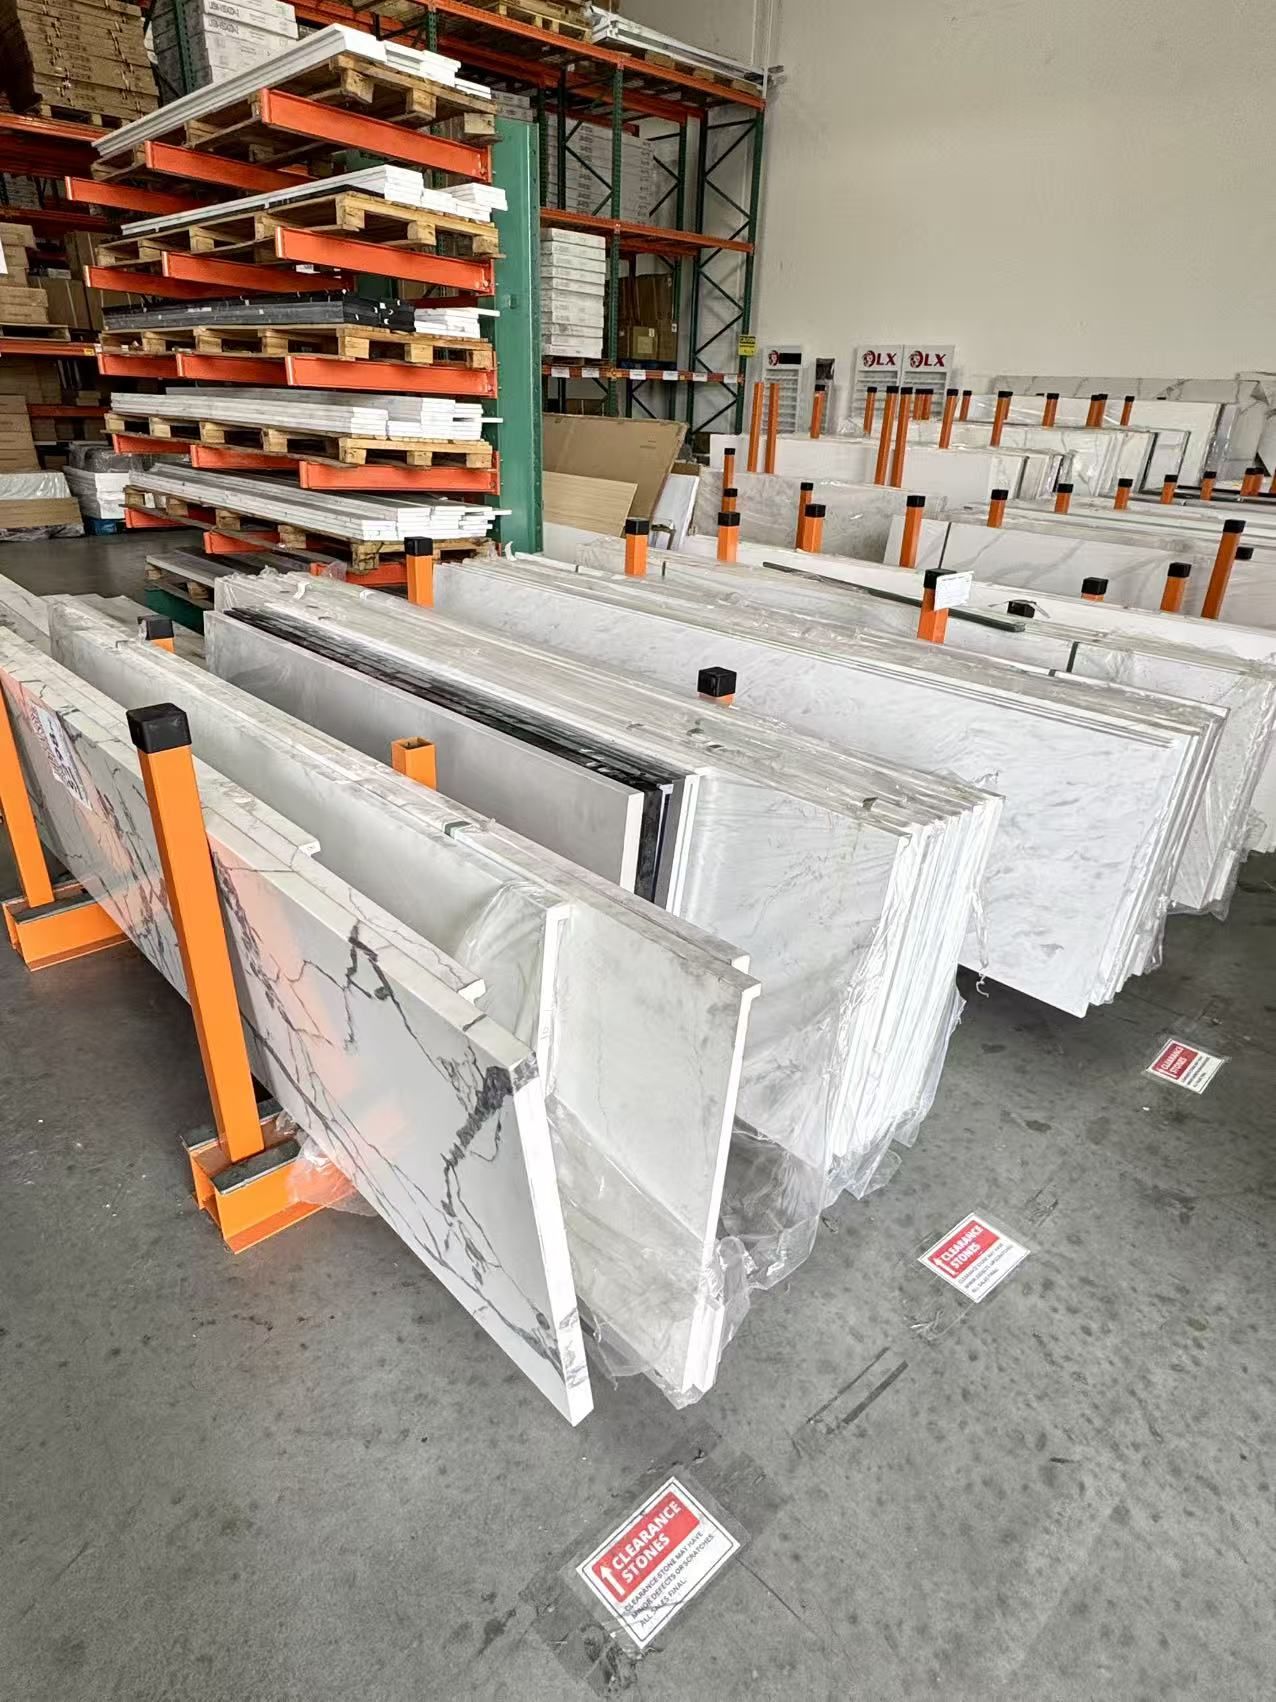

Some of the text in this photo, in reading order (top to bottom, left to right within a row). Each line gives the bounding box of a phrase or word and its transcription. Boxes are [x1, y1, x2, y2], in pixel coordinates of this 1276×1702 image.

[611, 1501, 682, 1570] CLEARANCE
[621, 1533, 671, 1584] STONES
[650, 1573, 676, 1601] DEFECTS
[674, 1563, 685, 1576] OR
[684, 1533, 714, 1566] SCRATCHES
[624, 1576, 658, 1612] CLEARANCE
[657, 1558, 676, 1579] STONE
[674, 1545, 689, 1560] MAY
[640, 1612, 652, 1628] ALL
